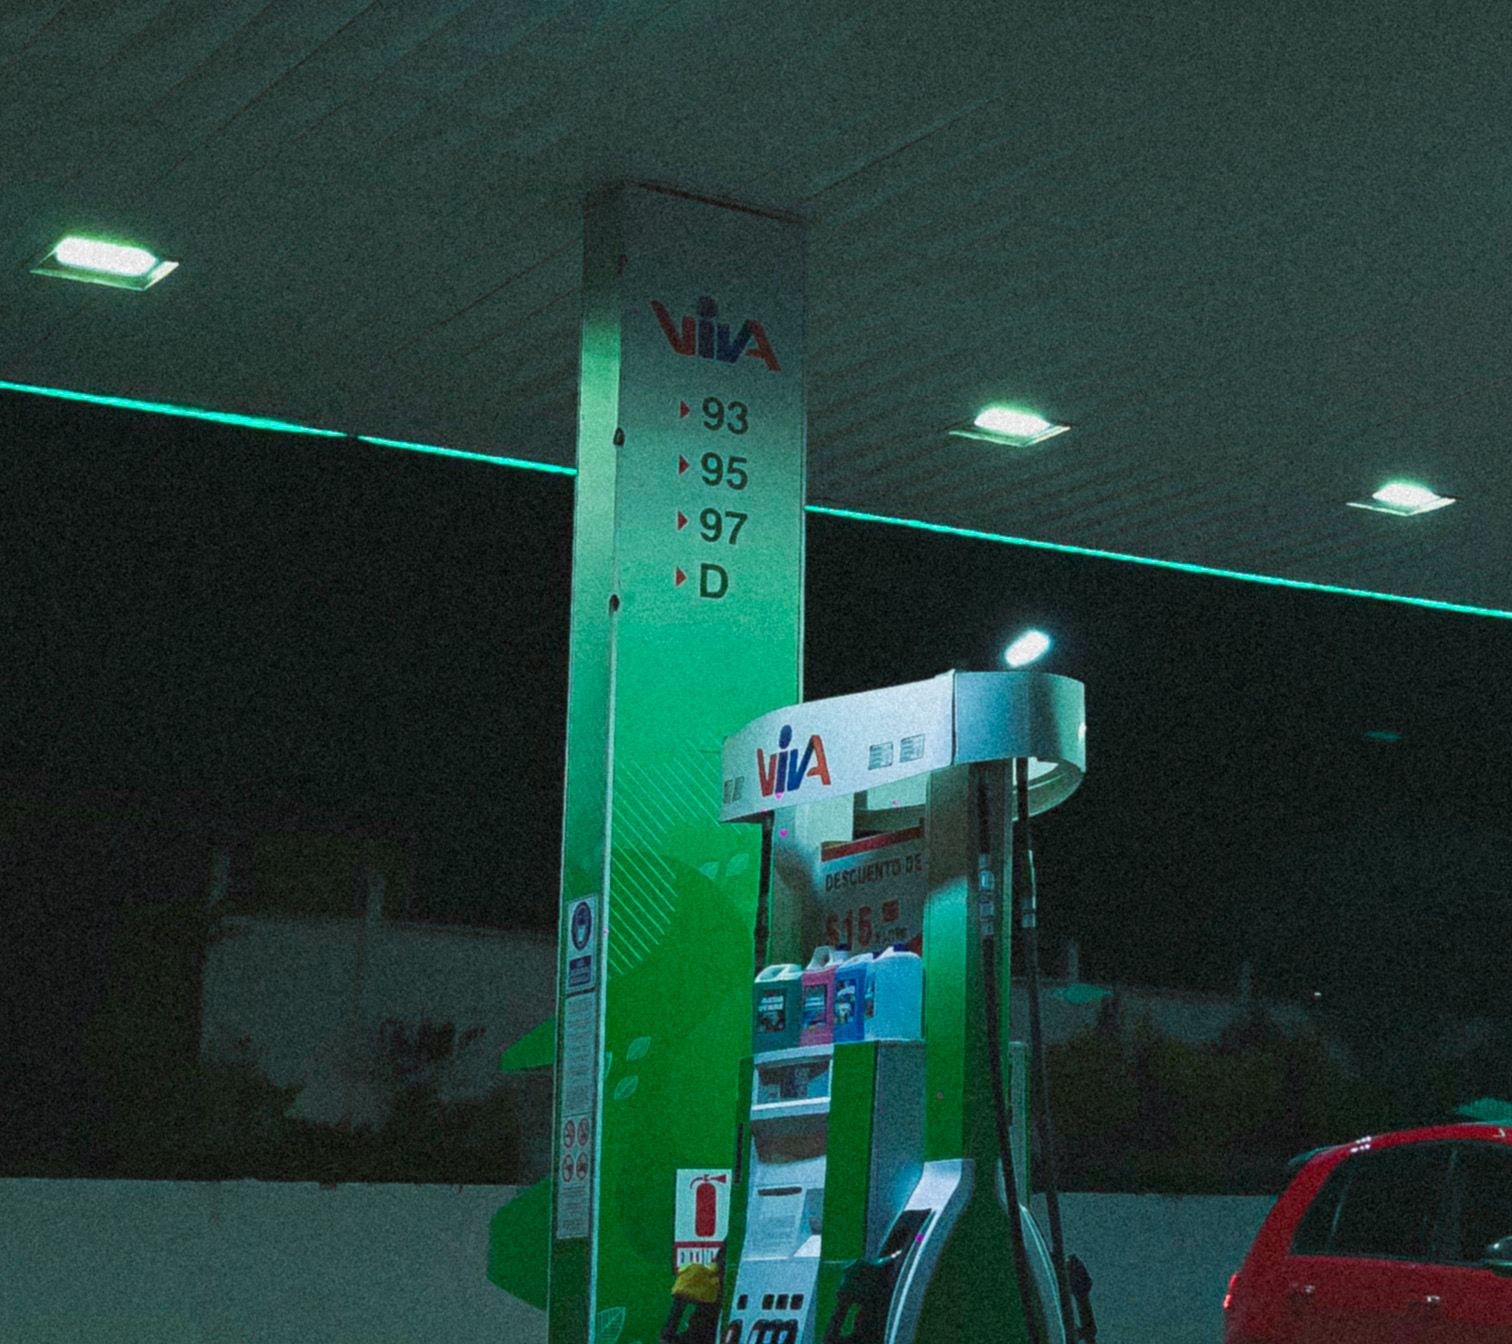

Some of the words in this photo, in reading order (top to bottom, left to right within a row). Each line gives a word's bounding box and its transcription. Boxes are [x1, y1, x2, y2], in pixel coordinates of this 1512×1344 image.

[701, 396, 749, 435] 93
[700, 451, 749, 491] 95
[699, 507, 749, 546] 97
[699, 562, 729, 599] D
[825, 858, 901, 893] DESCUENTO
